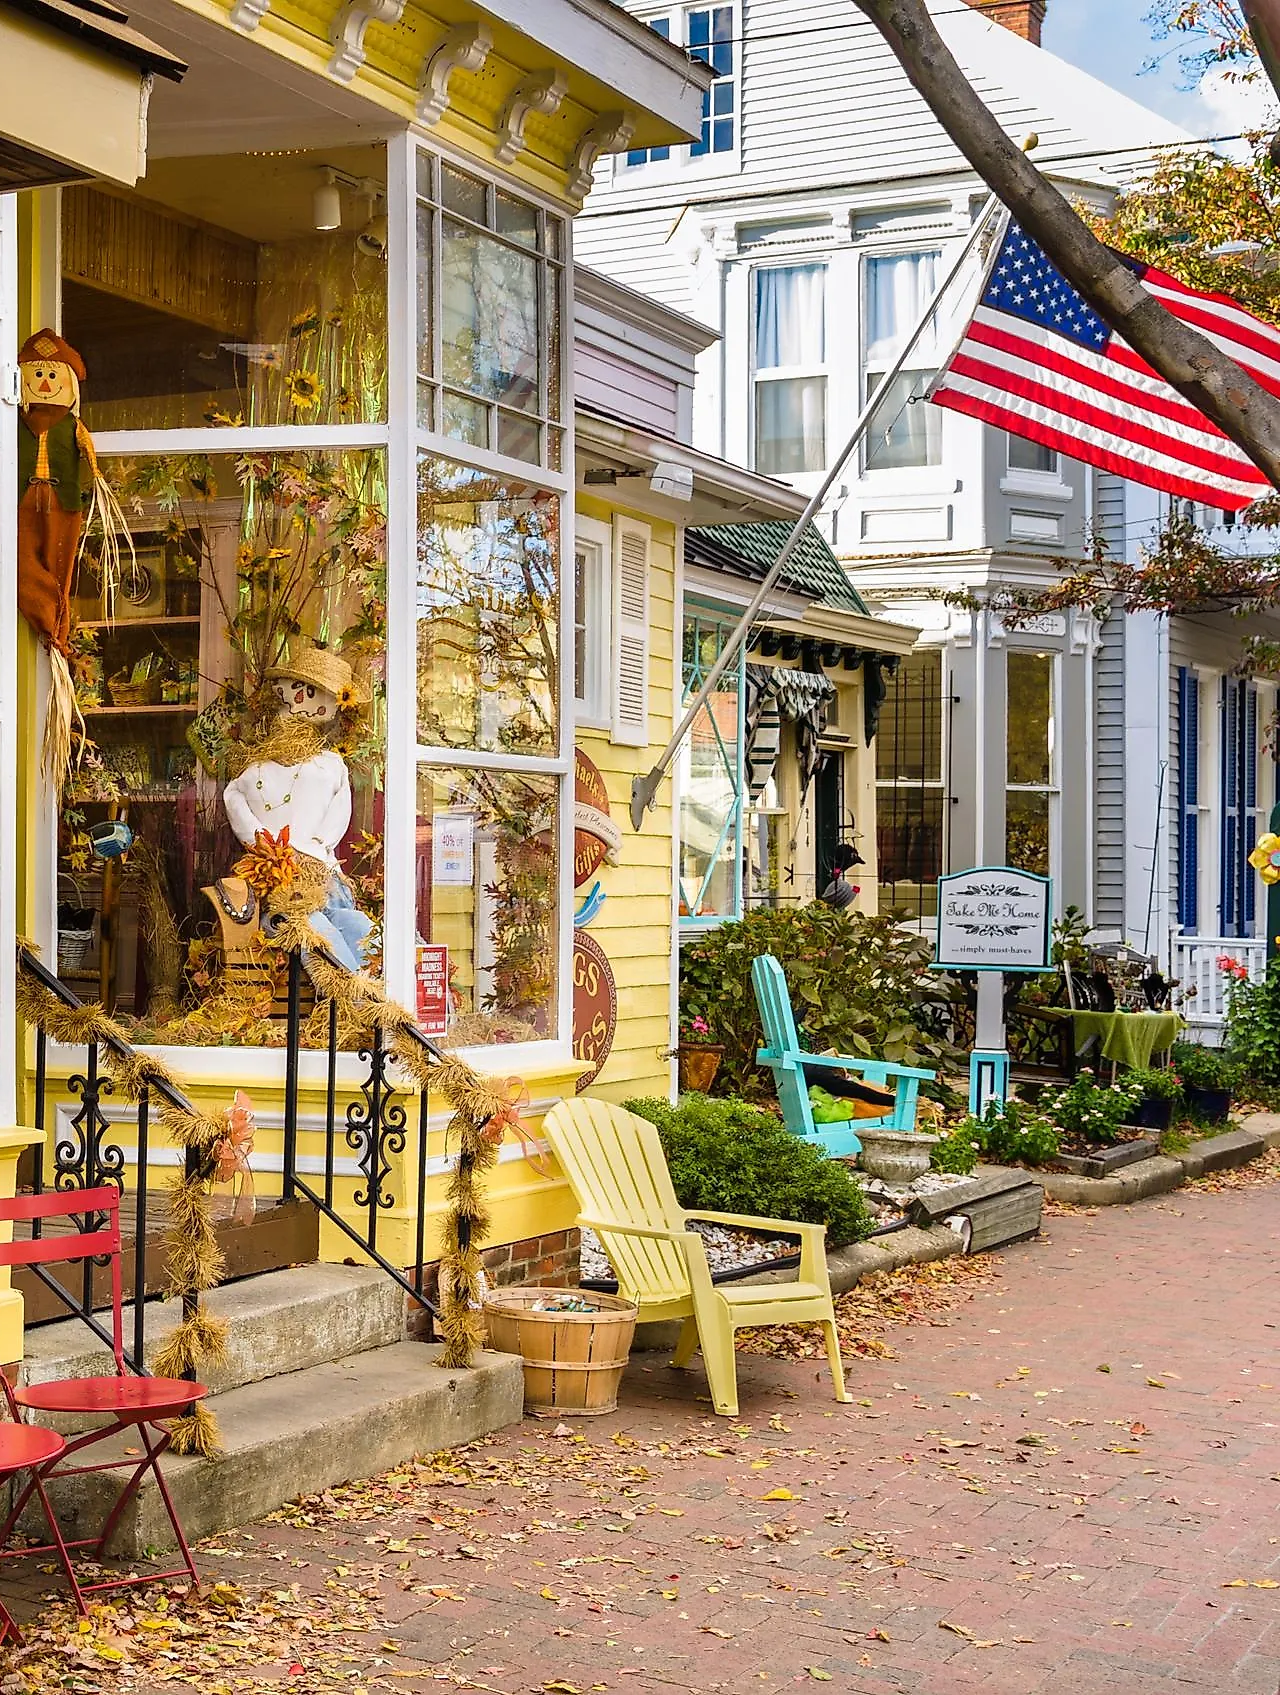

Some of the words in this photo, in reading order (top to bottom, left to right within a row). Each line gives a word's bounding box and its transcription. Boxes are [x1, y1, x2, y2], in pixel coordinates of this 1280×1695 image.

[575, 841, 600, 875] Gifts
[945, 901, 975, 917] Take
[1002, 902, 1041, 919] Home
